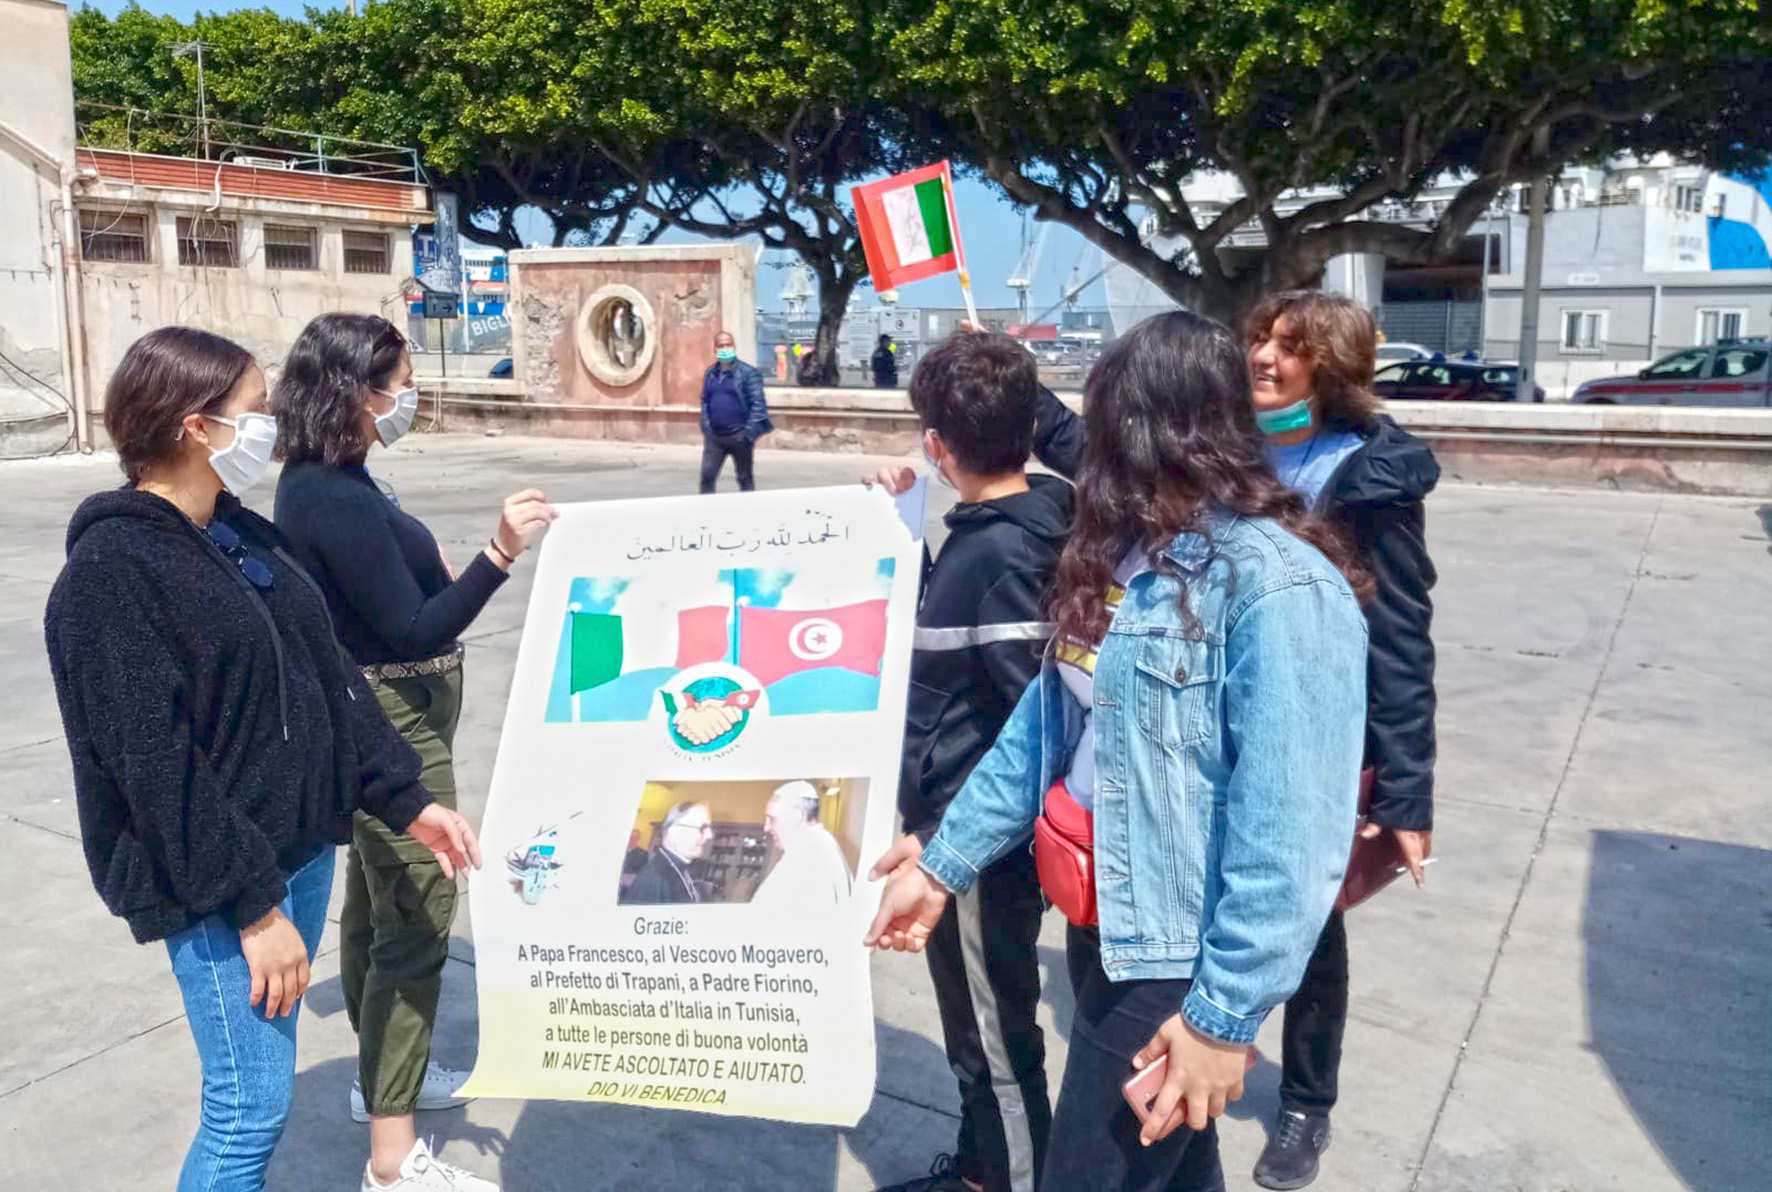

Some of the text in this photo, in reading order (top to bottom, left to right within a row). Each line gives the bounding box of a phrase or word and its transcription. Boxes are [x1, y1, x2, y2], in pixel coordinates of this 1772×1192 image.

[633, 916, 689, 936] Grazie:
[517, 944, 829, 969] A Papa Francesco, al Vescovo Mogavero,
[530, 970, 819, 997] al Prefetto di Trapani, a Padre Fiorino,
[549, 997, 801, 1026] all'Ambasciata d'Italia in Tunisia,
[545, 1024, 809, 1054] a tutte le persone di buona volontà
[542, 1050, 807, 1085] MI AVETE ASCOLTATO E AIUTATO.
[586, 1080, 620, 1097] DIO
[621, 1083, 639, 1098] VI
